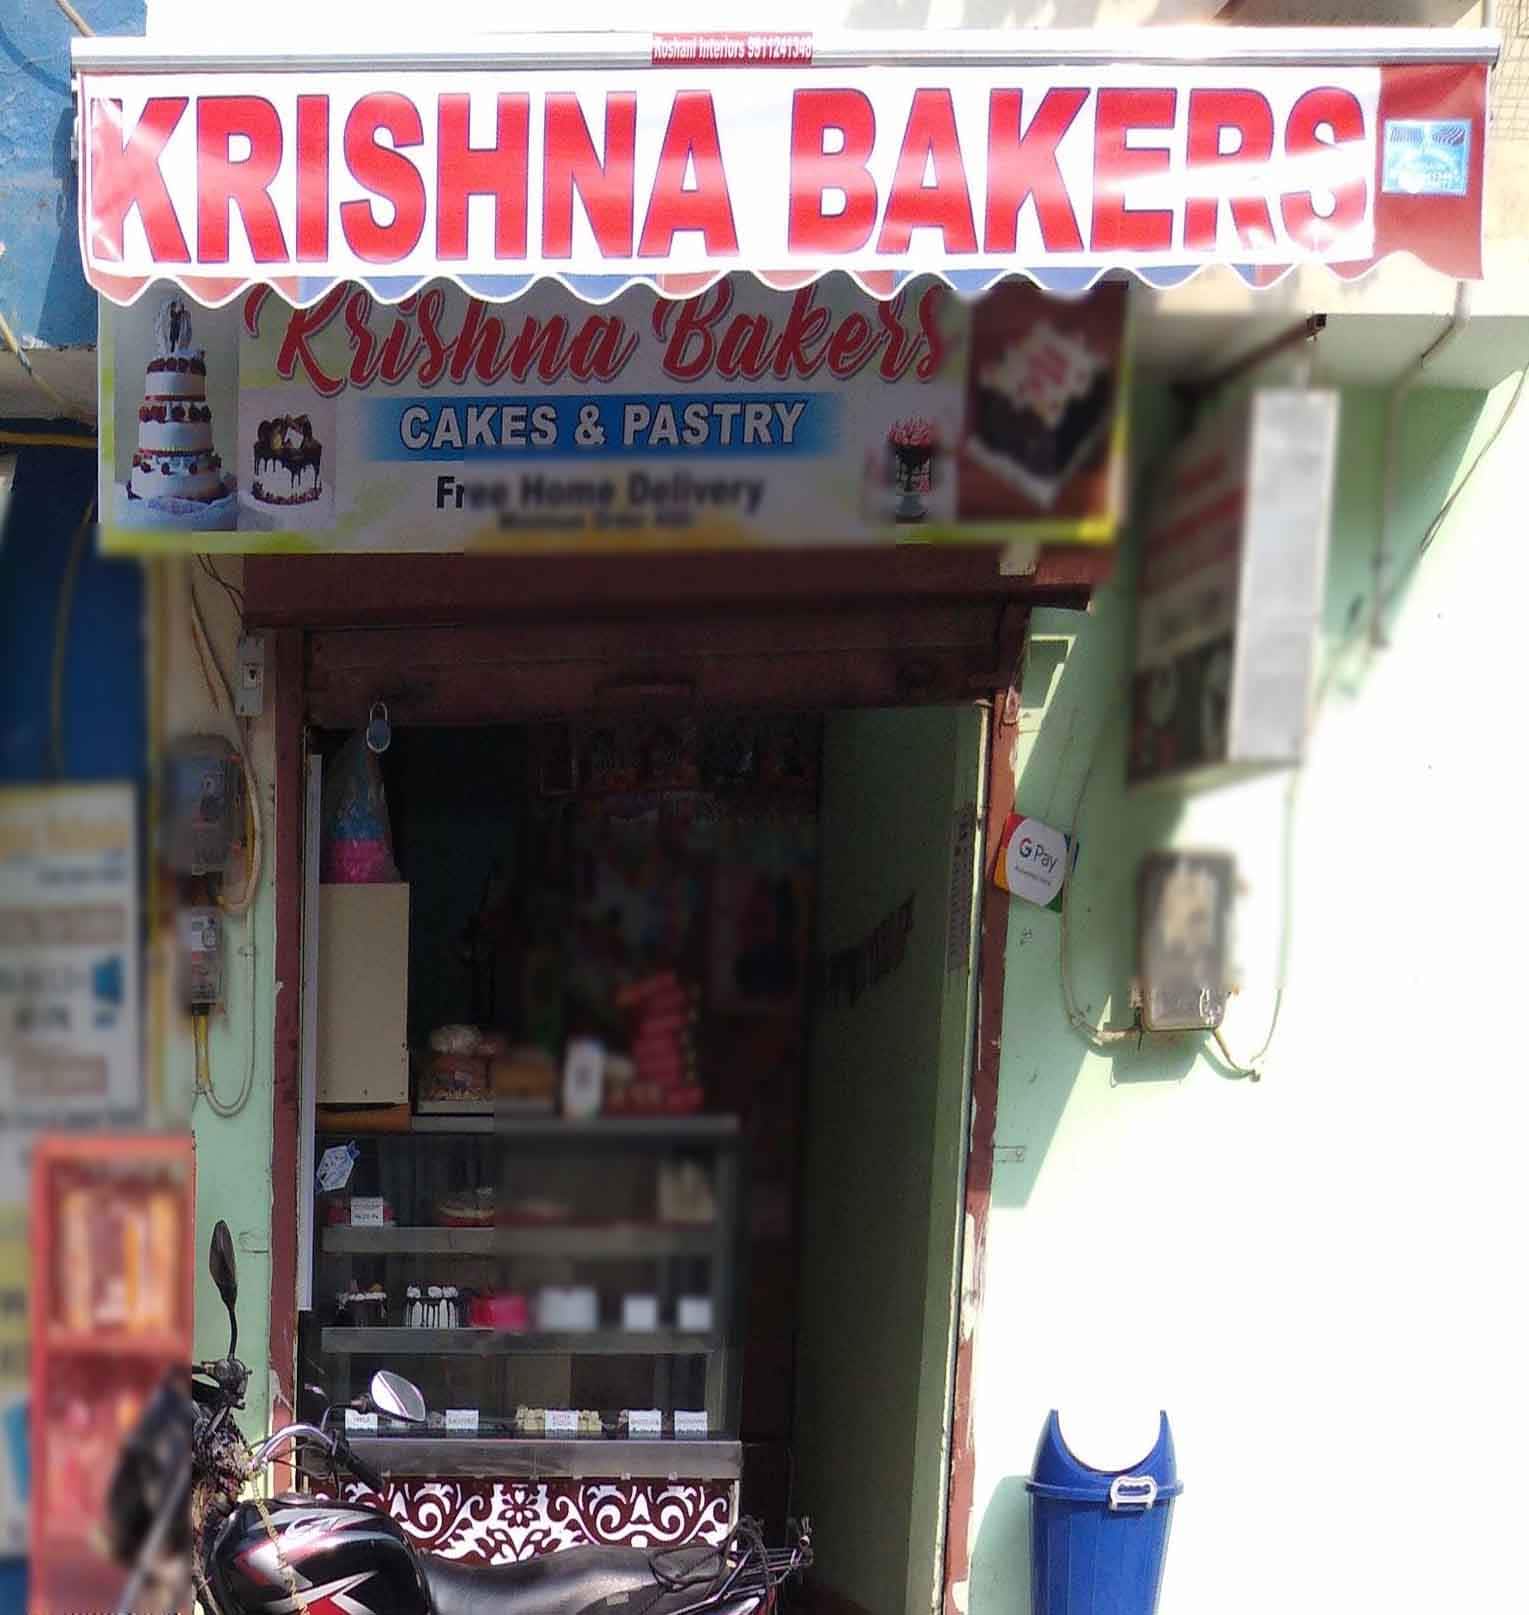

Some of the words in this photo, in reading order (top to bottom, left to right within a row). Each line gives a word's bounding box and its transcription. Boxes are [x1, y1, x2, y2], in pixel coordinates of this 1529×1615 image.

[90, 90, 740, 263] KRISHNA
[788, 86, 1369, 255] BAKERS
[243, 283, 638, 398] Krishna
[652, 280, 946, 384] Bakers
[400, 404, 559, 451] CAKES
[574, 403, 606, 449] &
[623, 401, 806, 447] PASTRY
[520, 474, 616, 507] Home
